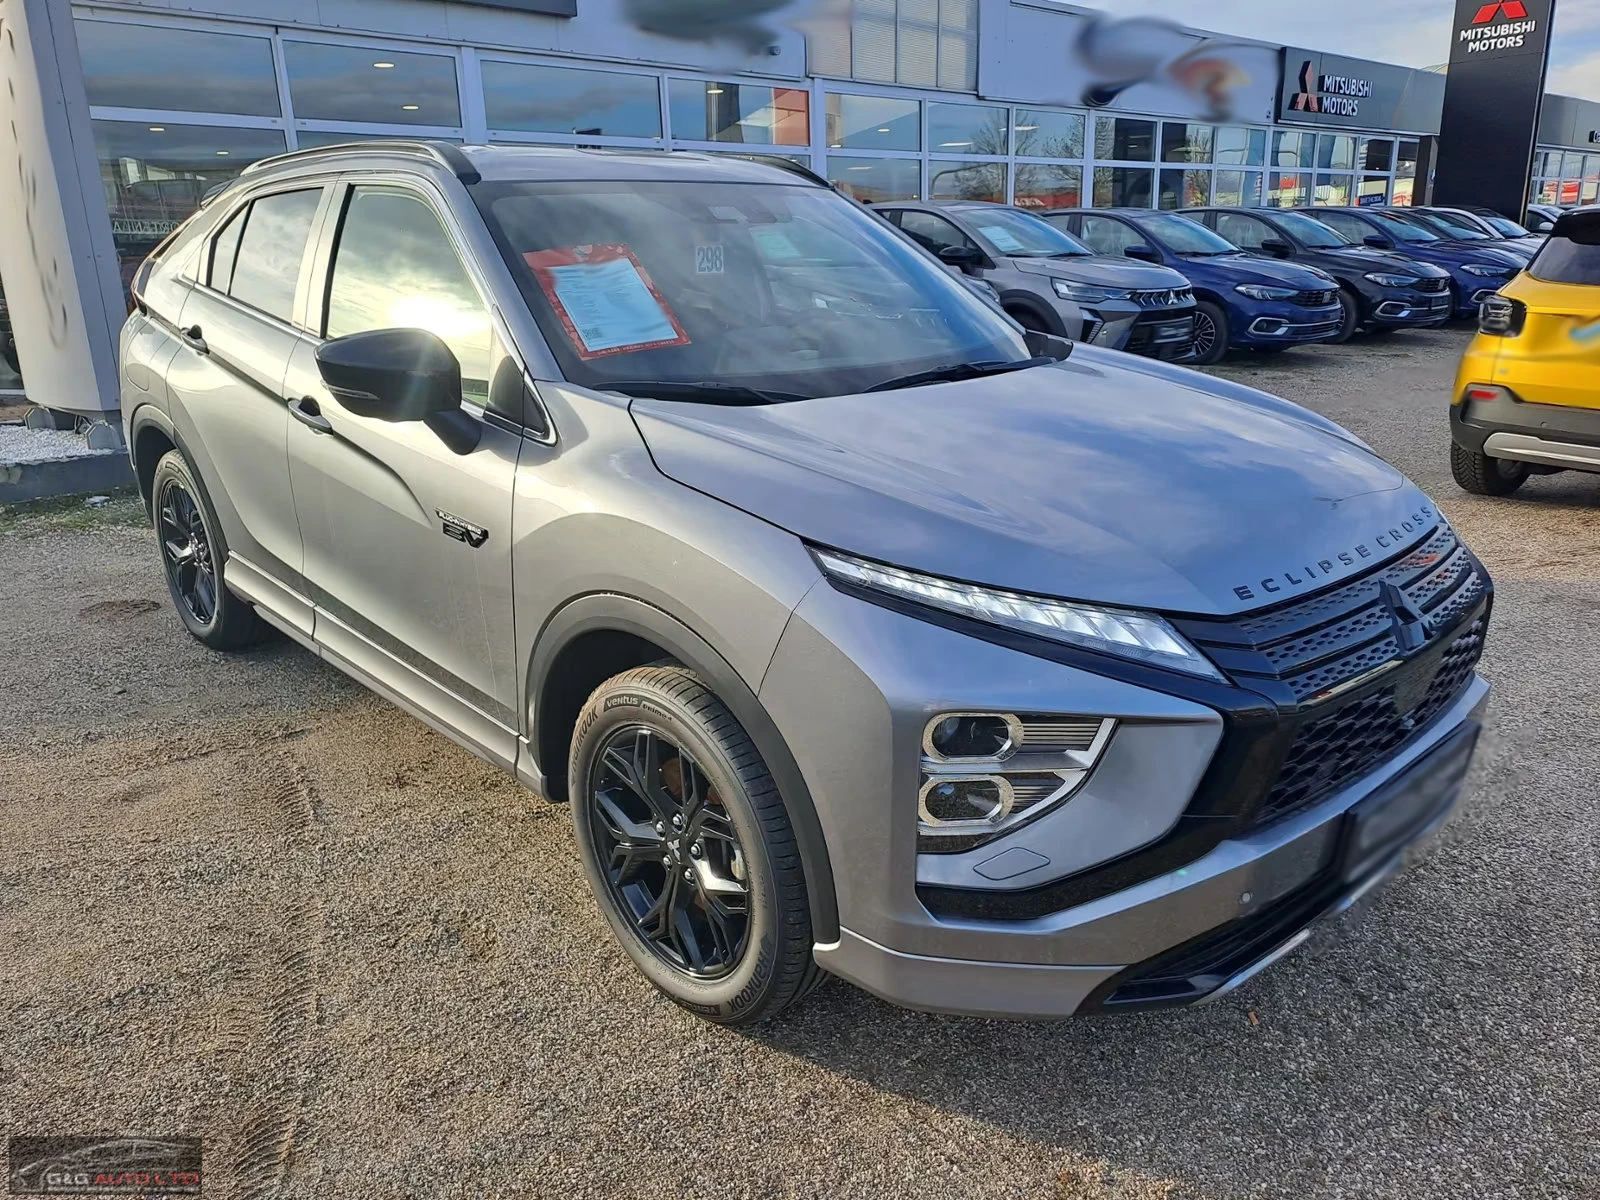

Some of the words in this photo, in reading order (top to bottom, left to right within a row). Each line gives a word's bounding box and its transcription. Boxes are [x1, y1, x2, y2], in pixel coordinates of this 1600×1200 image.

[1460, 20, 1536, 41] MITSUBISHI
[1468, 35, 1524, 53] MOTORS
[1323, 74, 1374, 97] MITSUBISHI
[1321, 96, 1359, 116] MOTORS
[697, 246, 723, 272] 298
[1233, 544, 1371, 601] ECLIPSE
[1375, 506, 1433, 549] CROSS
